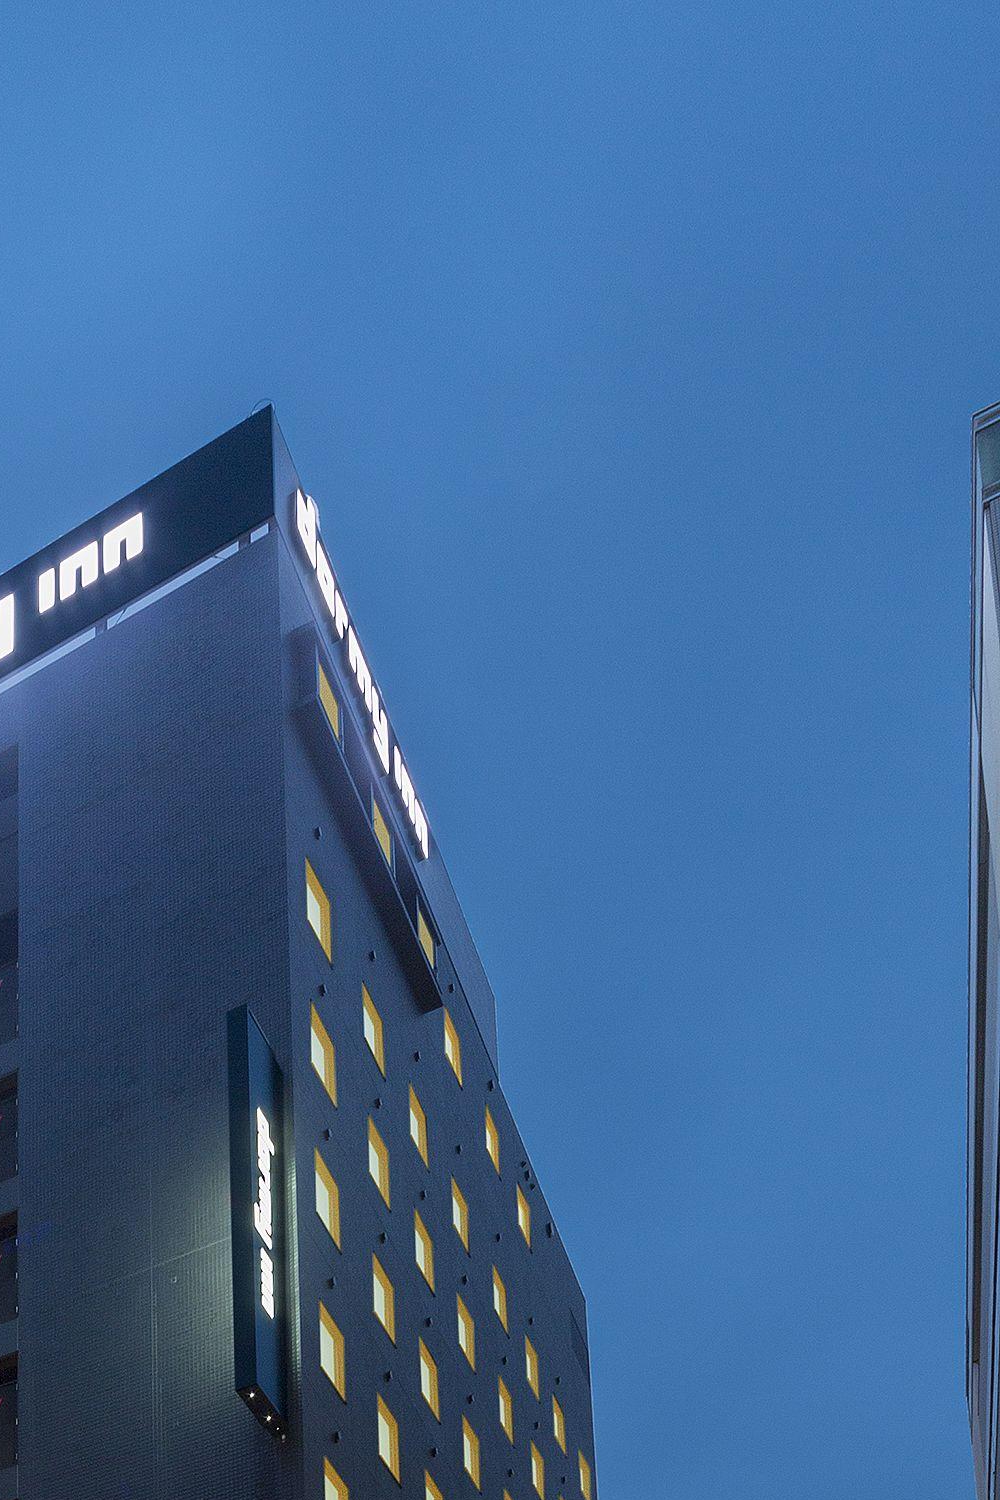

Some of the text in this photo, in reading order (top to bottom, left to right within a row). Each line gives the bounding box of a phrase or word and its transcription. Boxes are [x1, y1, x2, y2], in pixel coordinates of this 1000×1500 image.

[38, 512, 144, 614] inn
[296, 488, 429, 859] dormy inn
